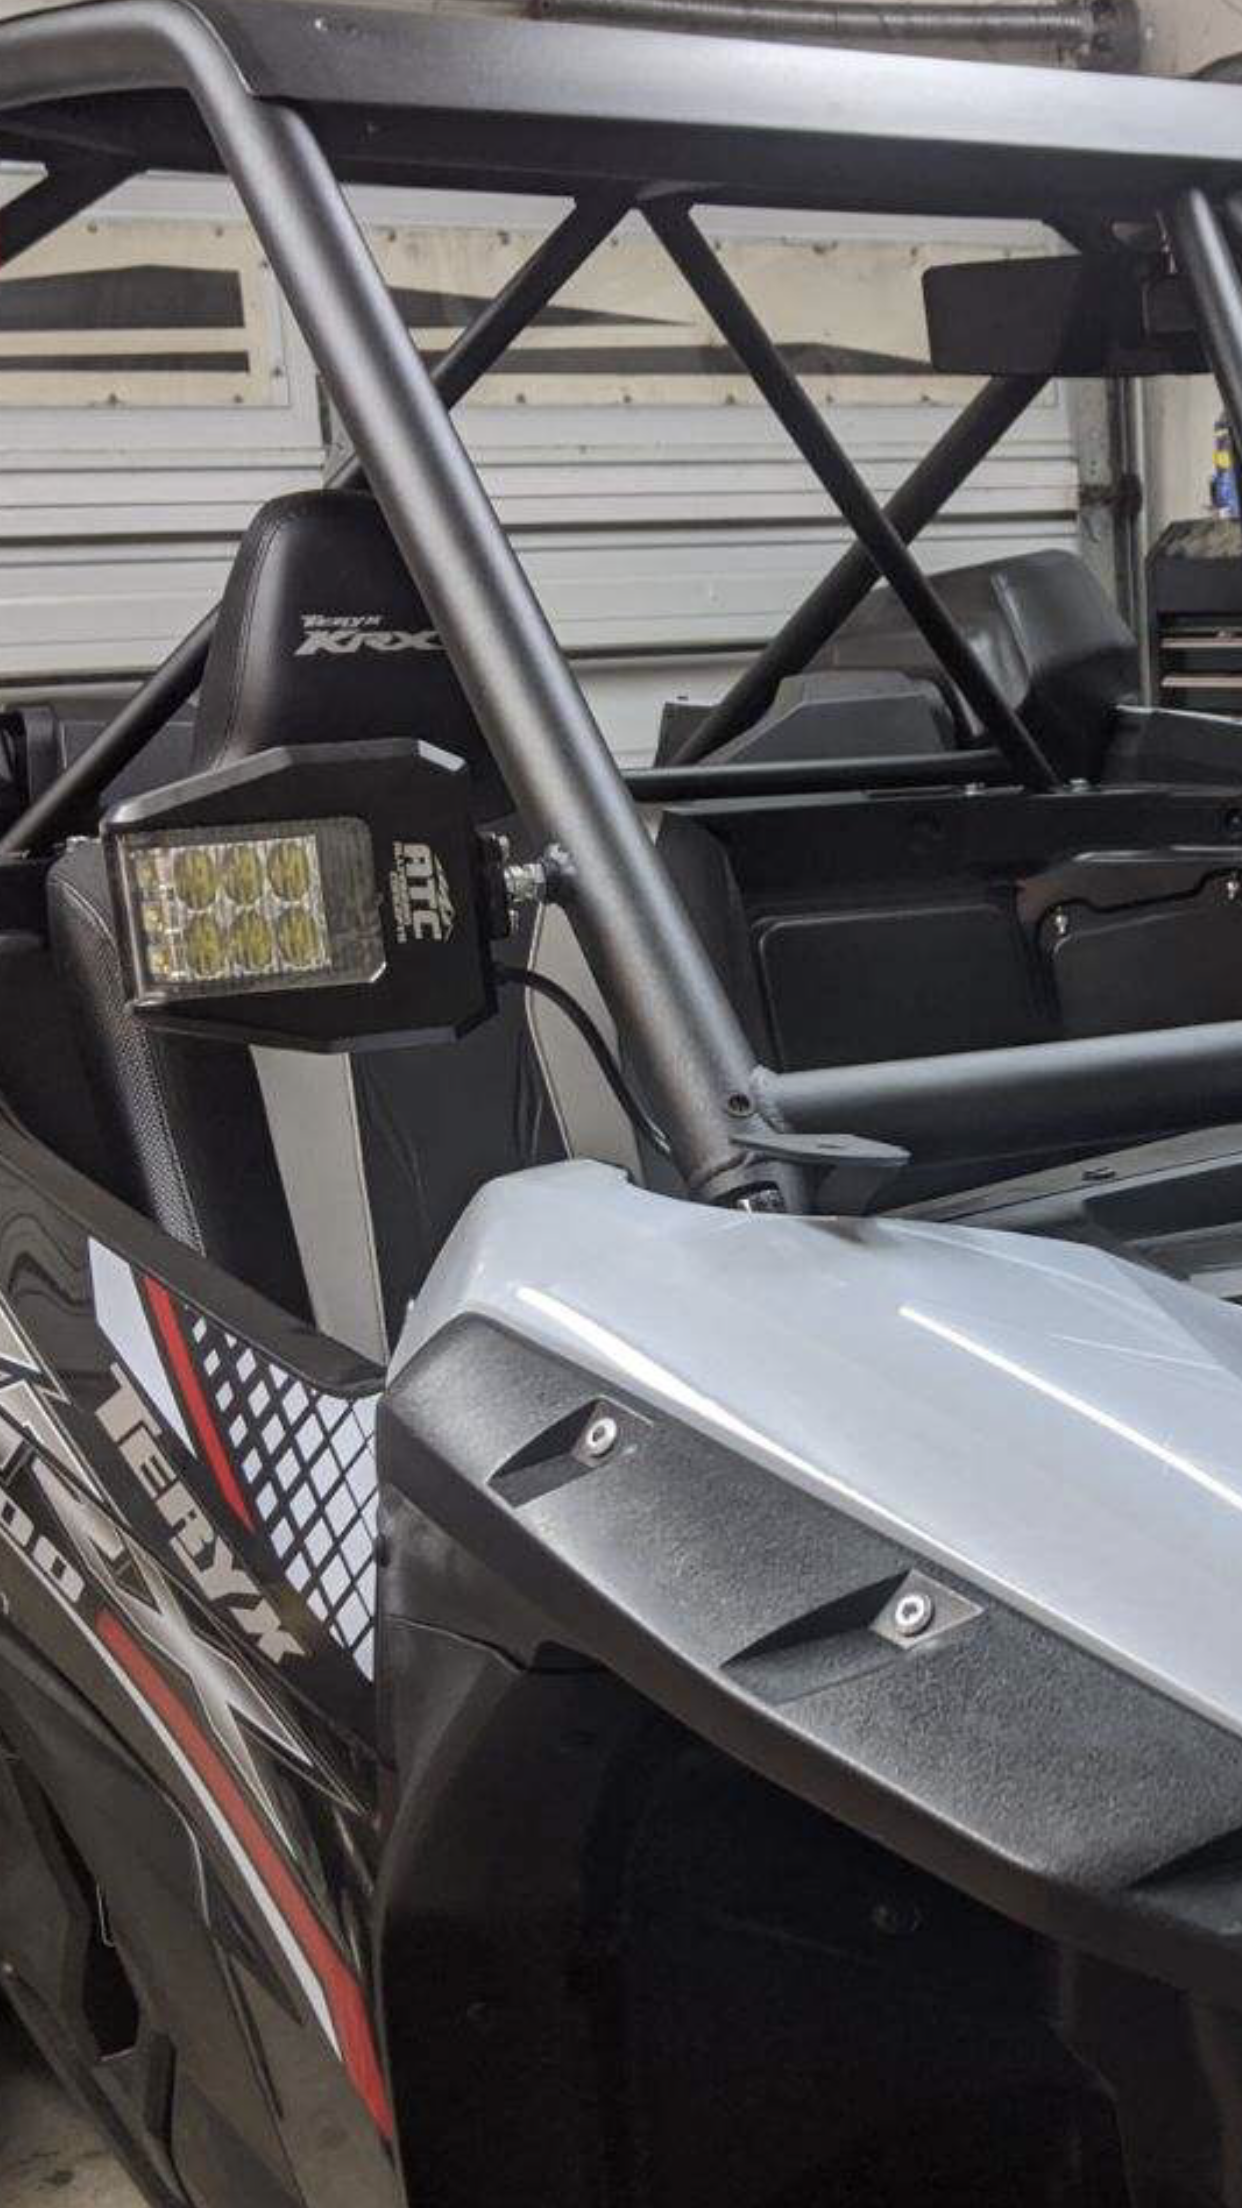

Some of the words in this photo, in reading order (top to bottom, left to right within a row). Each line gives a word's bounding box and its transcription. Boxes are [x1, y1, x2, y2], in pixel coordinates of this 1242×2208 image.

[294, 630, 444, 655] KRX
[403, 843, 441, 940] ATC
[95, 1362, 306, 1664] TERYX
